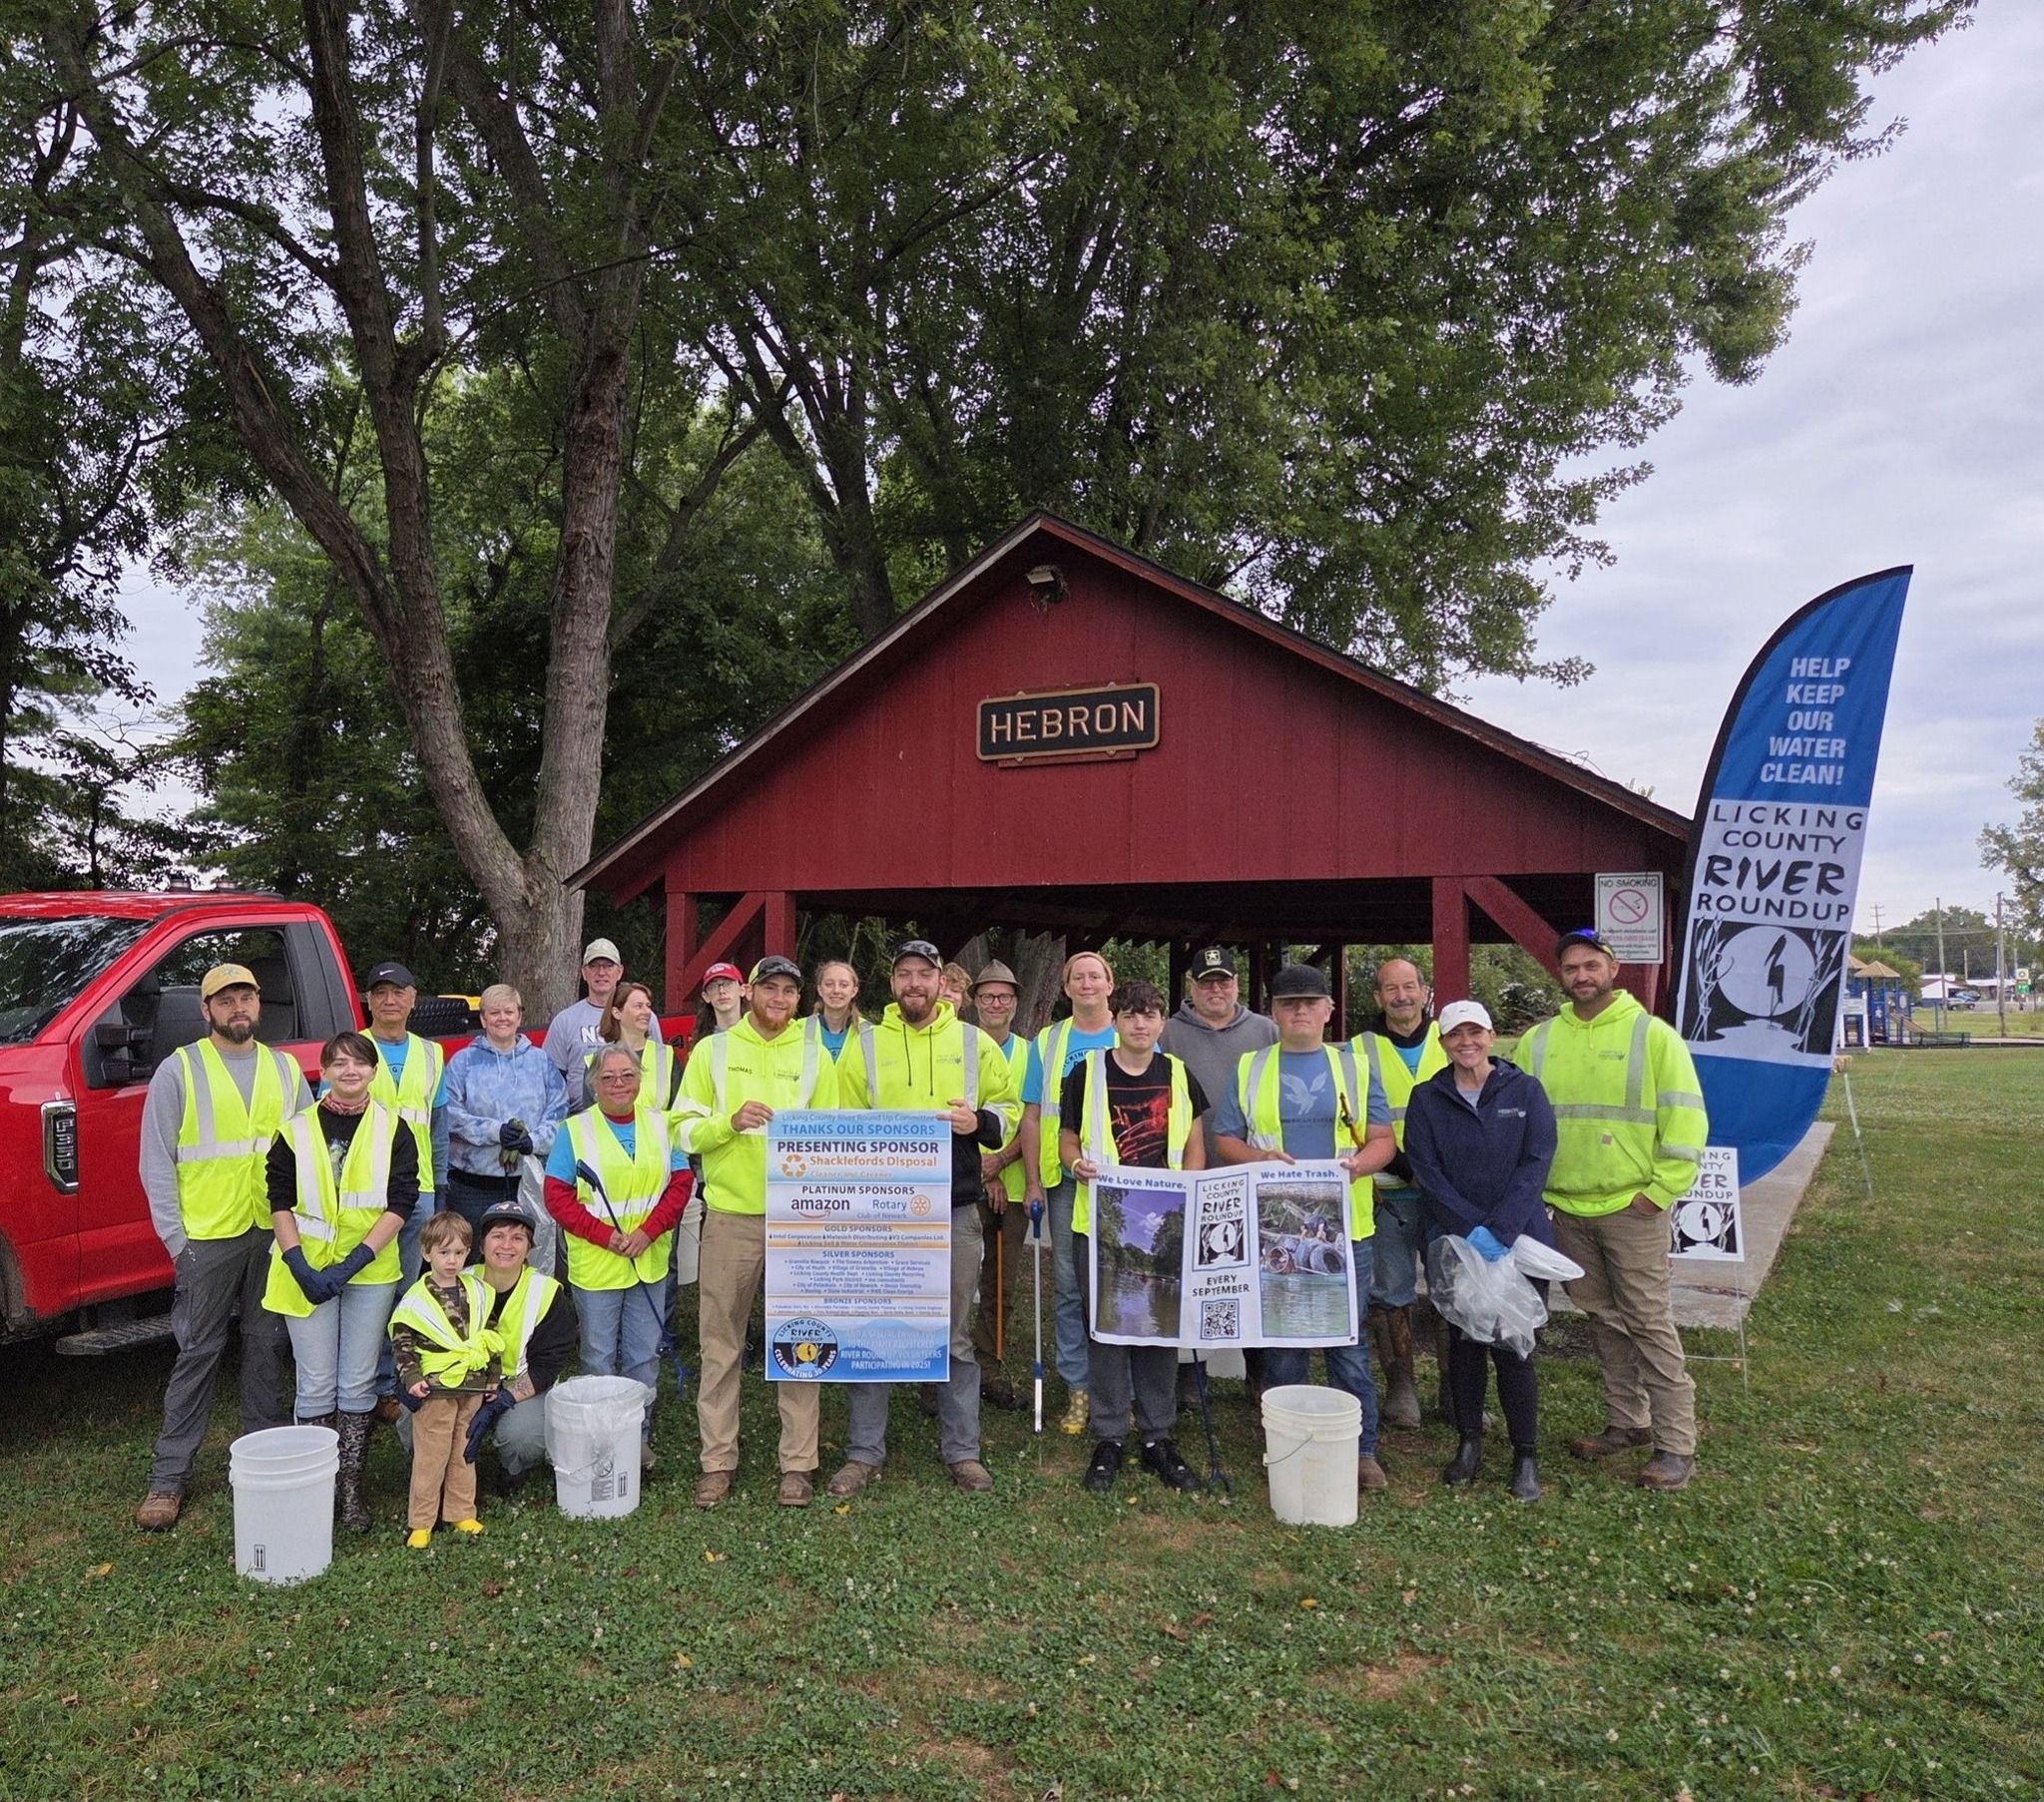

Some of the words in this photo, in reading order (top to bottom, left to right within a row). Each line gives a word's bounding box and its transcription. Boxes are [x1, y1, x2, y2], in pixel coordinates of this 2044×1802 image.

[1790, 658, 1850, 678] HELP
[1786, 683, 1844, 704] KEEP
[991, 700, 1144, 743] HEBRON
[1788, 710, 1834, 731] OUR
[1769, 736, 1846, 758] WATER
[1761, 762, 1844, 785] CLEAN!
[1713, 804, 1864, 831] LICKING
[1723, 830, 1846, 854] COUNTY
[1704, 854, 1844, 896] RIVER
[1601, 879, 1613, 888] NO
[1616, 878, 1657, 887] SMOKING
[1697, 893, 1849, 922] ROUNDUP
[782, 1124, 833, 1134] THANKS
[836, 1125, 864, 1134] OUR
[868, 1125, 935, 1135] SPONSORS
[777, 1141, 866, 1153] PRESENTING
[870, 1141, 938, 1153] SPONSOR
[809, 1155, 884, 1166] Shacklefords
[887, 1156, 937, 1168] Disposal
[1262, 1170, 1277, 1179] We
[1278, 1169, 1301, 1179] Hate
[1303, 1169, 1339, 1179] Trash.
[1099, 1173, 1114, 1183] We
[1117, 1175, 1143, 1186] Love
[1145, 1177, 1187, 1189] Nature.
[1203, 1179, 1245, 1192] LICKING
[802, 1185, 855, 1194] PLATINUM
[859, 1185, 915, 1195] SPONSORS
[1207, 1188, 1240, 1199] COUNTY
[1685, 1190, 1733, 1199] UNDUP
[791, 1198, 850, 1210] amazon
[872, 1199, 907, 1211] Rotary
[1203, 1197, 1241, 1214] RIVER
[1201, 1209, 1244, 1222] ROUNDUP
[849, 1224, 892, 1233] SPONSORS
[1207, 1274, 1238, 1286] EVERY
[1192, 1283, 1250, 1297] SEPTEMBER
[790, 1328, 820, 1337] RIVER
[774, 1349, 812, 1378] CELEBRATING
[822, 1349, 836, 1370] YEARS
